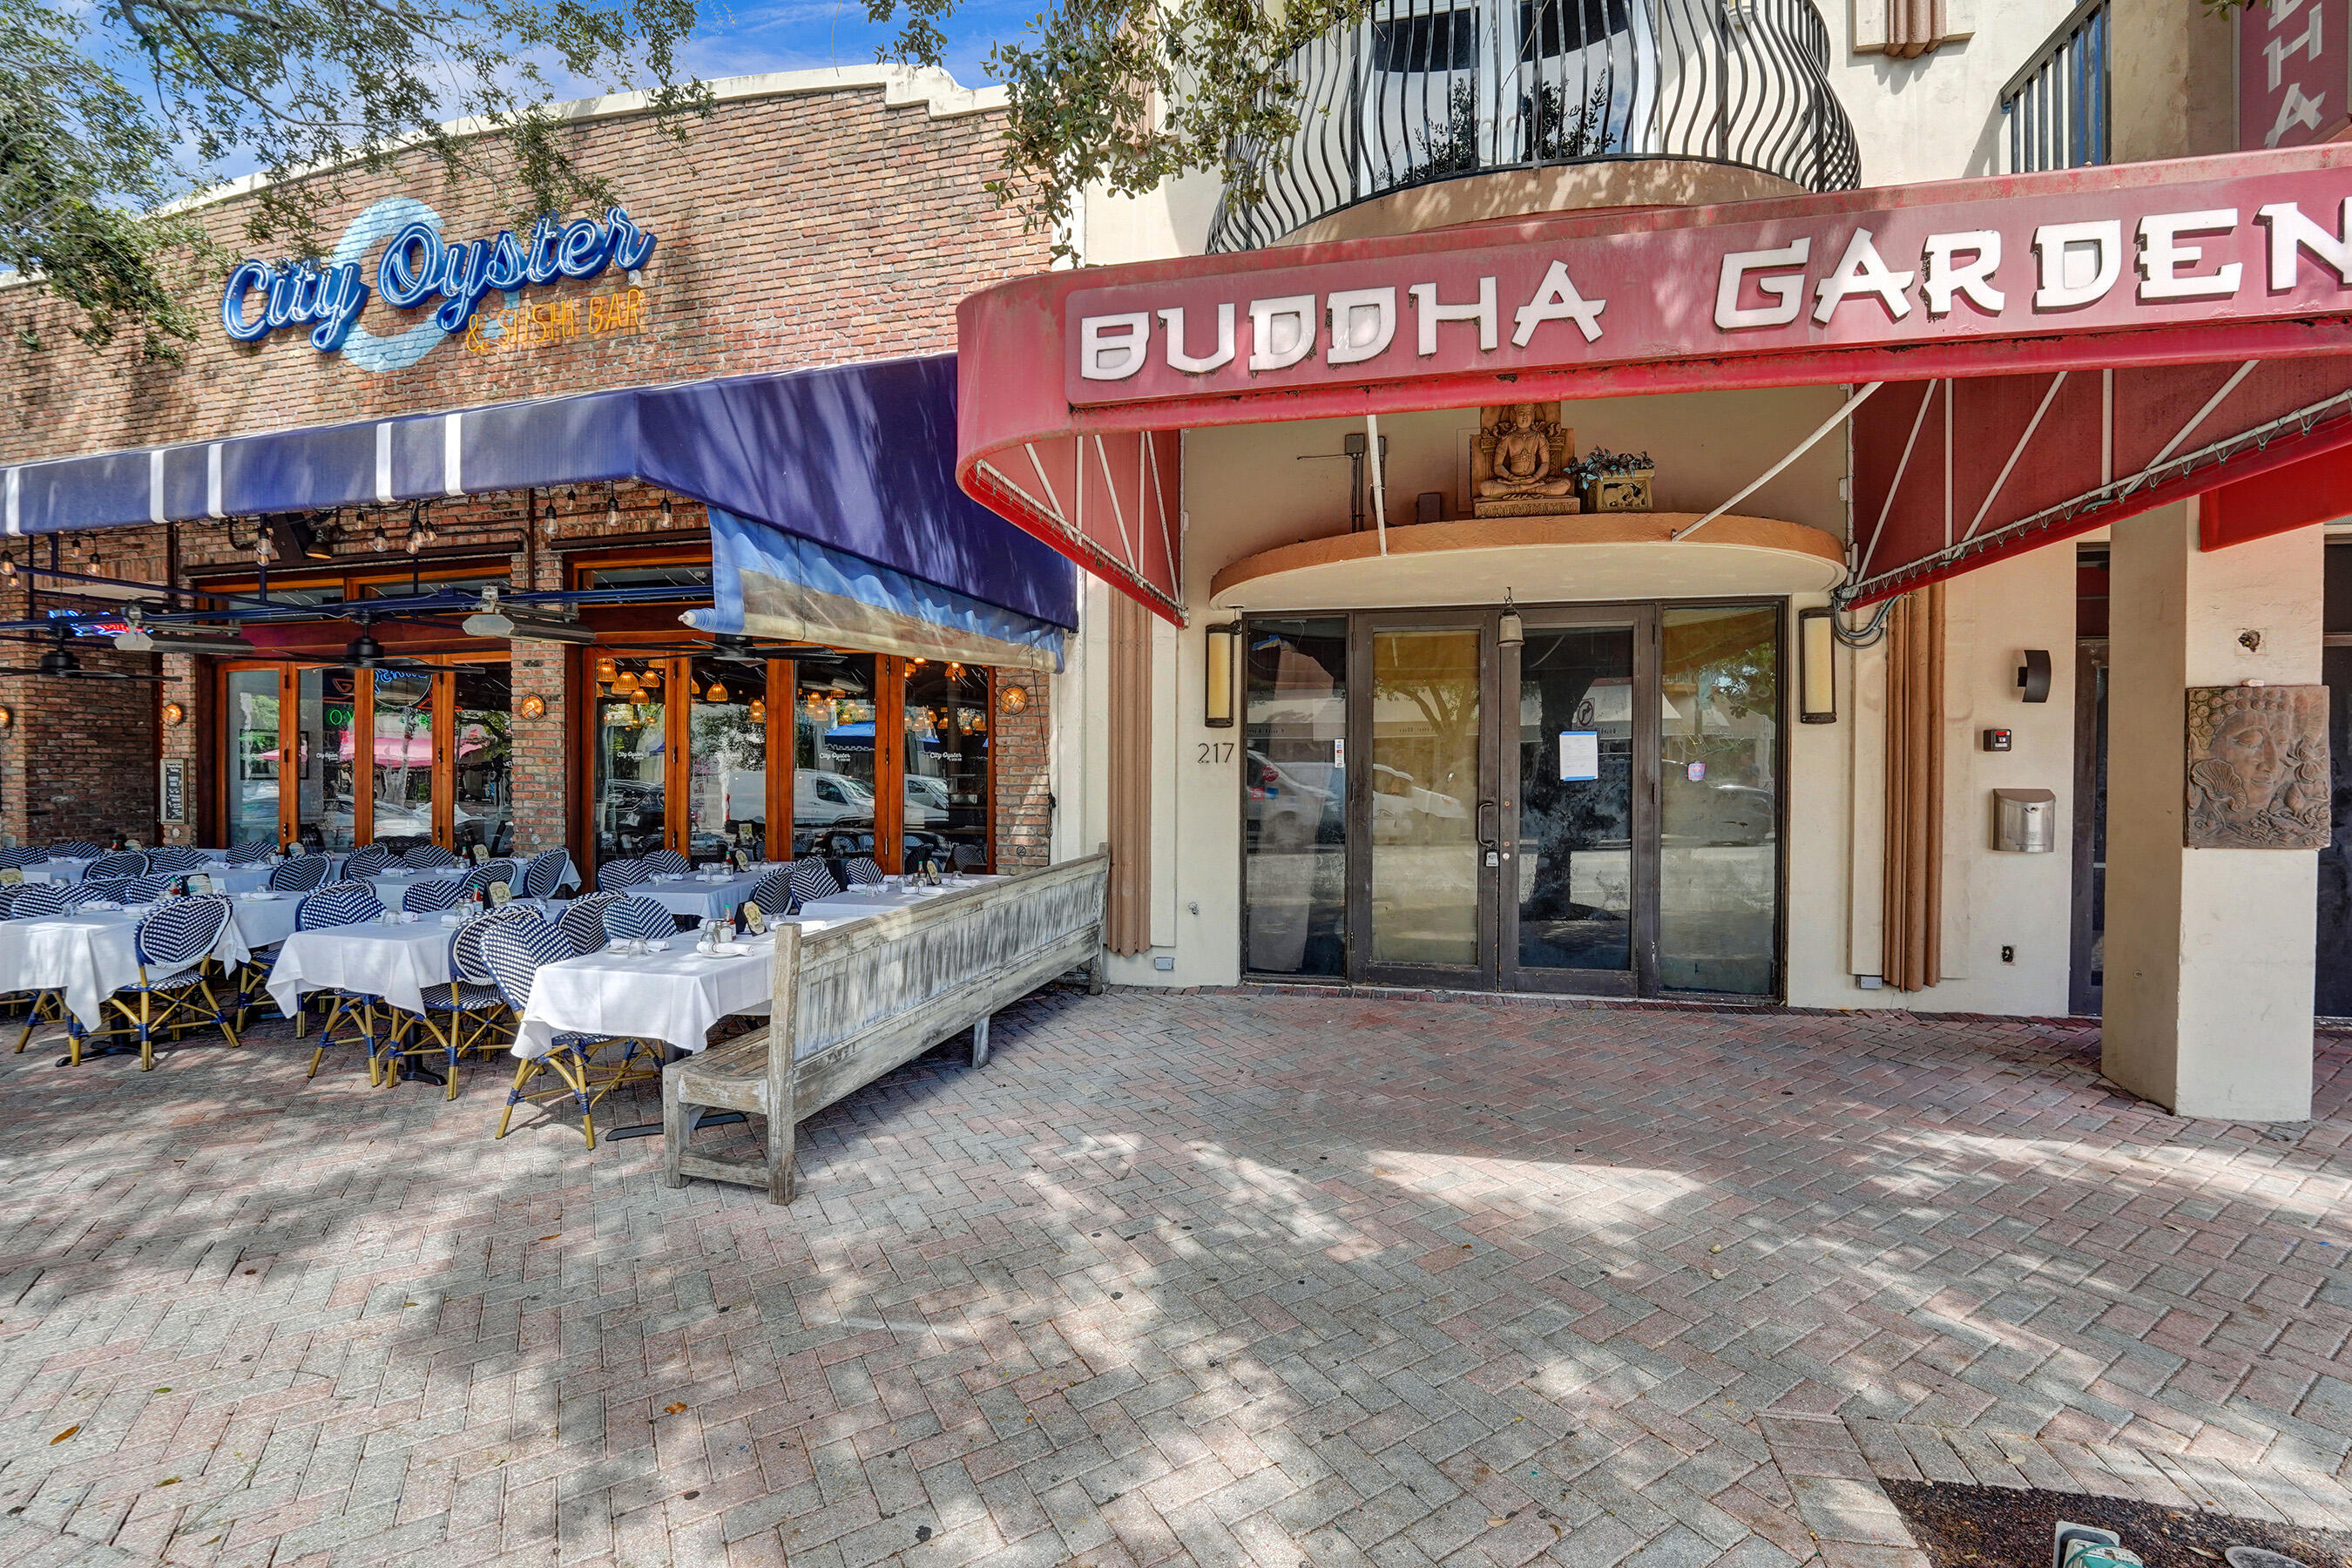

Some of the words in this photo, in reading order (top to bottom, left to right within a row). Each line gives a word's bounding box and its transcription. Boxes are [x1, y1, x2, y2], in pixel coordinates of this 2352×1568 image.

[222, 258, 370, 353] City
[377, 206, 658, 334] Oyster
[466, 314, 487, 352] &
[497, 296, 576, 348] SUSHI
[587, 288, 641, 335] BAR
[1081, 260, 1606, 381] BUDDHA
[1713, 196, 2352, 330] GARDEN
[1197, 742, 1234, 764] 217
